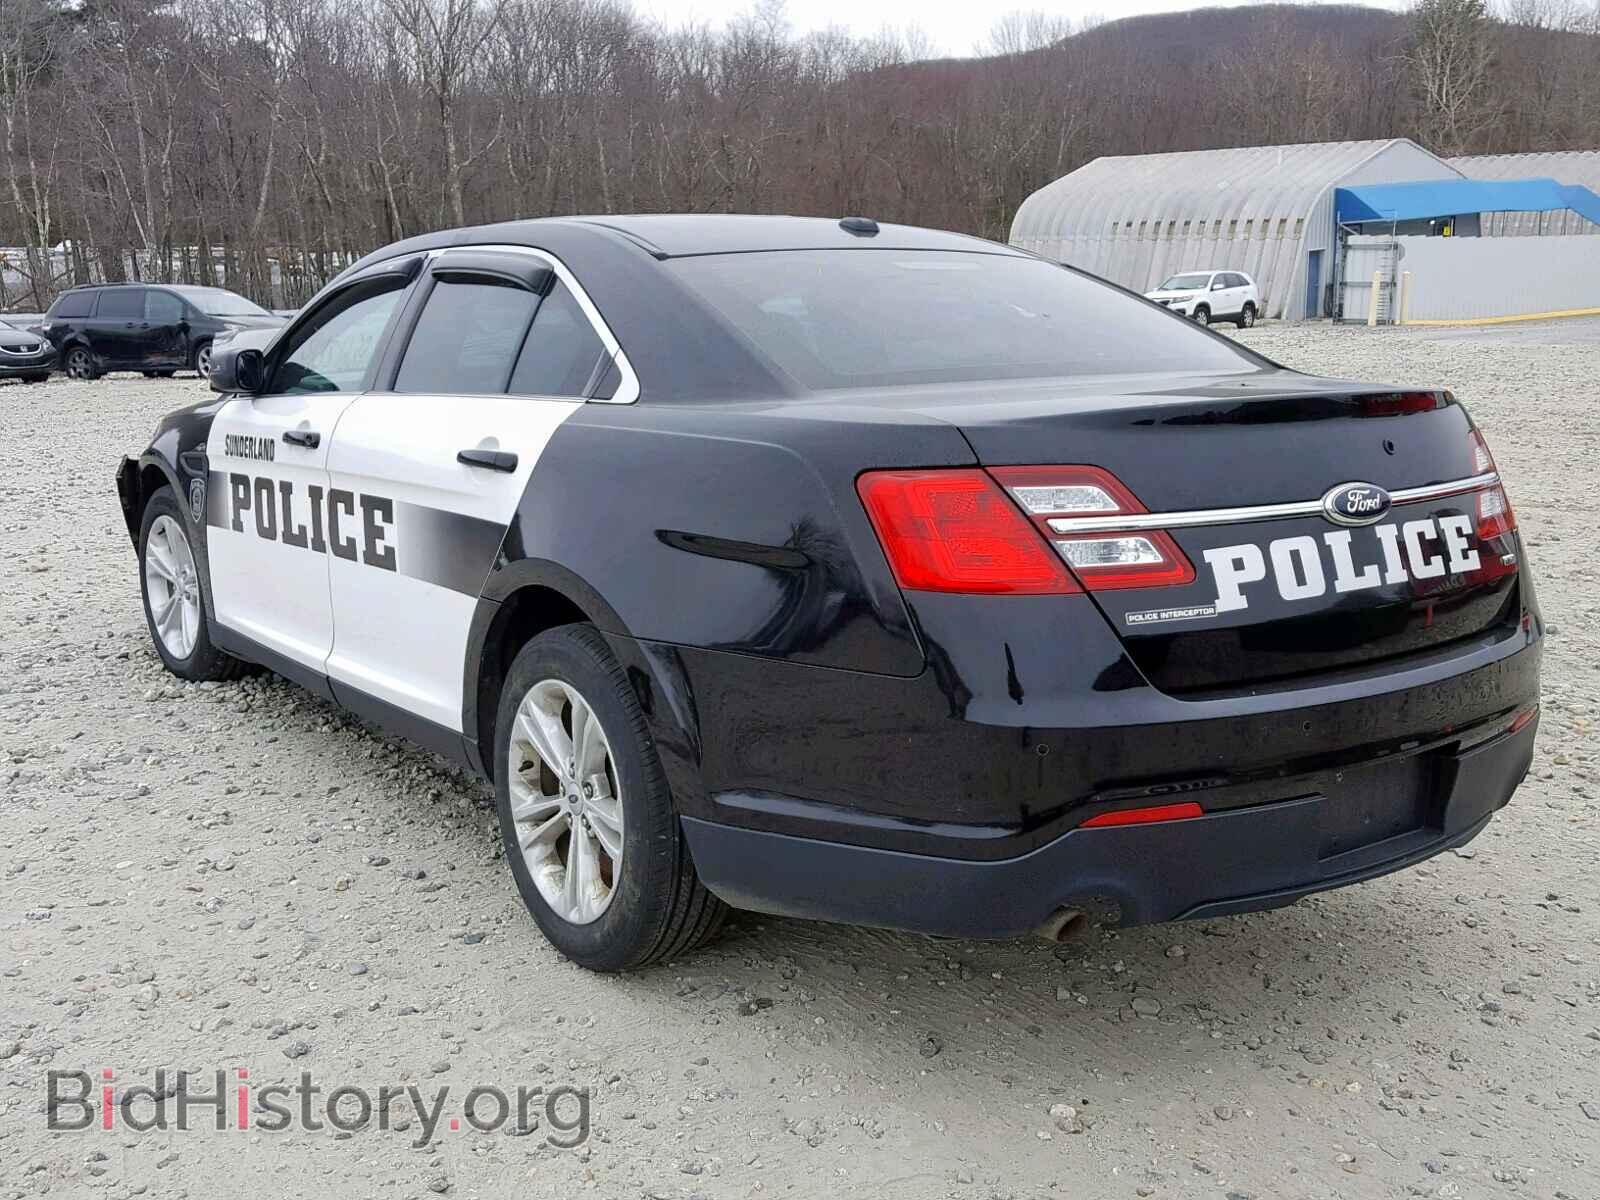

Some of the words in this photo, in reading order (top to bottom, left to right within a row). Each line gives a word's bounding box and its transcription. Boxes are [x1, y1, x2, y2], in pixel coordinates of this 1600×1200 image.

[224, 433, 276, 462] SUNDERLAND
[1347, 489, 1380, 513] Ford
[230, 472, 397, 572] POLICE
[1203, 514, 1482, 612] POLICE
[1128, 612, 1159, 622] POLICE
[1160, 607, 1215, 619] INTERCEPTOR
